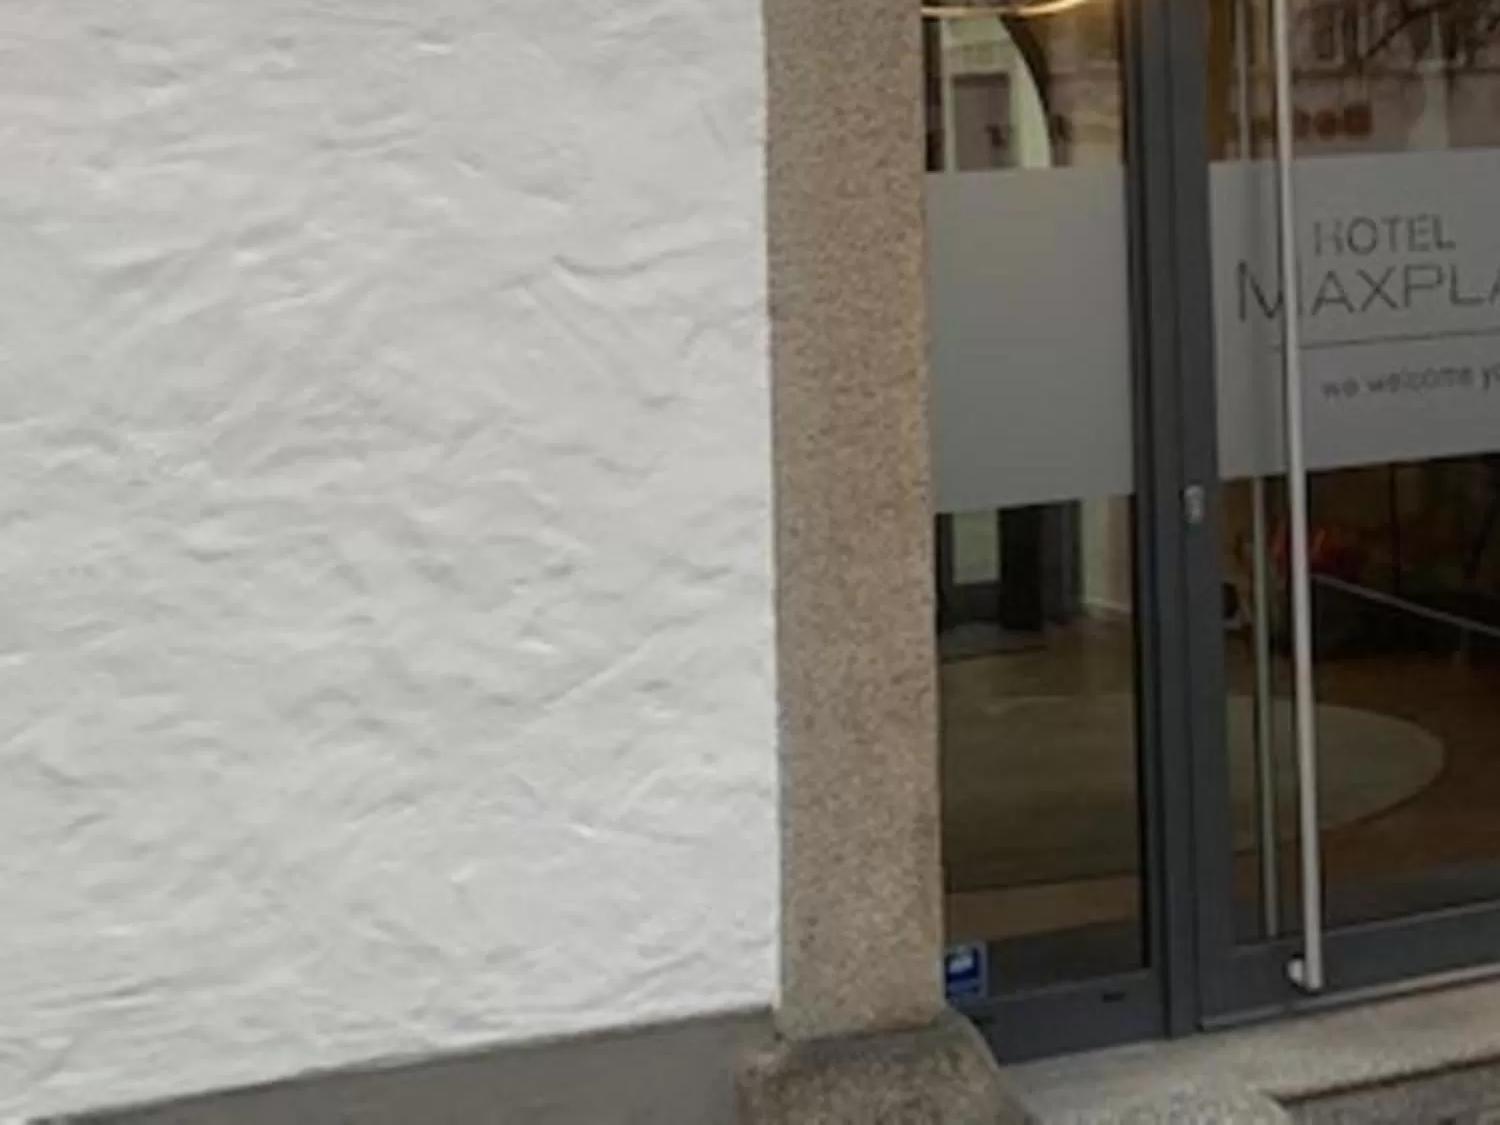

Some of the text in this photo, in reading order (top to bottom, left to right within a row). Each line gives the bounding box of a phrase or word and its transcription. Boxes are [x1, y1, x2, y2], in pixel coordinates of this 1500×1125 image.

[1312, 214, 1457, 256] HOTEL
[1320, 378, 1360, 399] we
[1367, 365, 1474, 394] welcome
